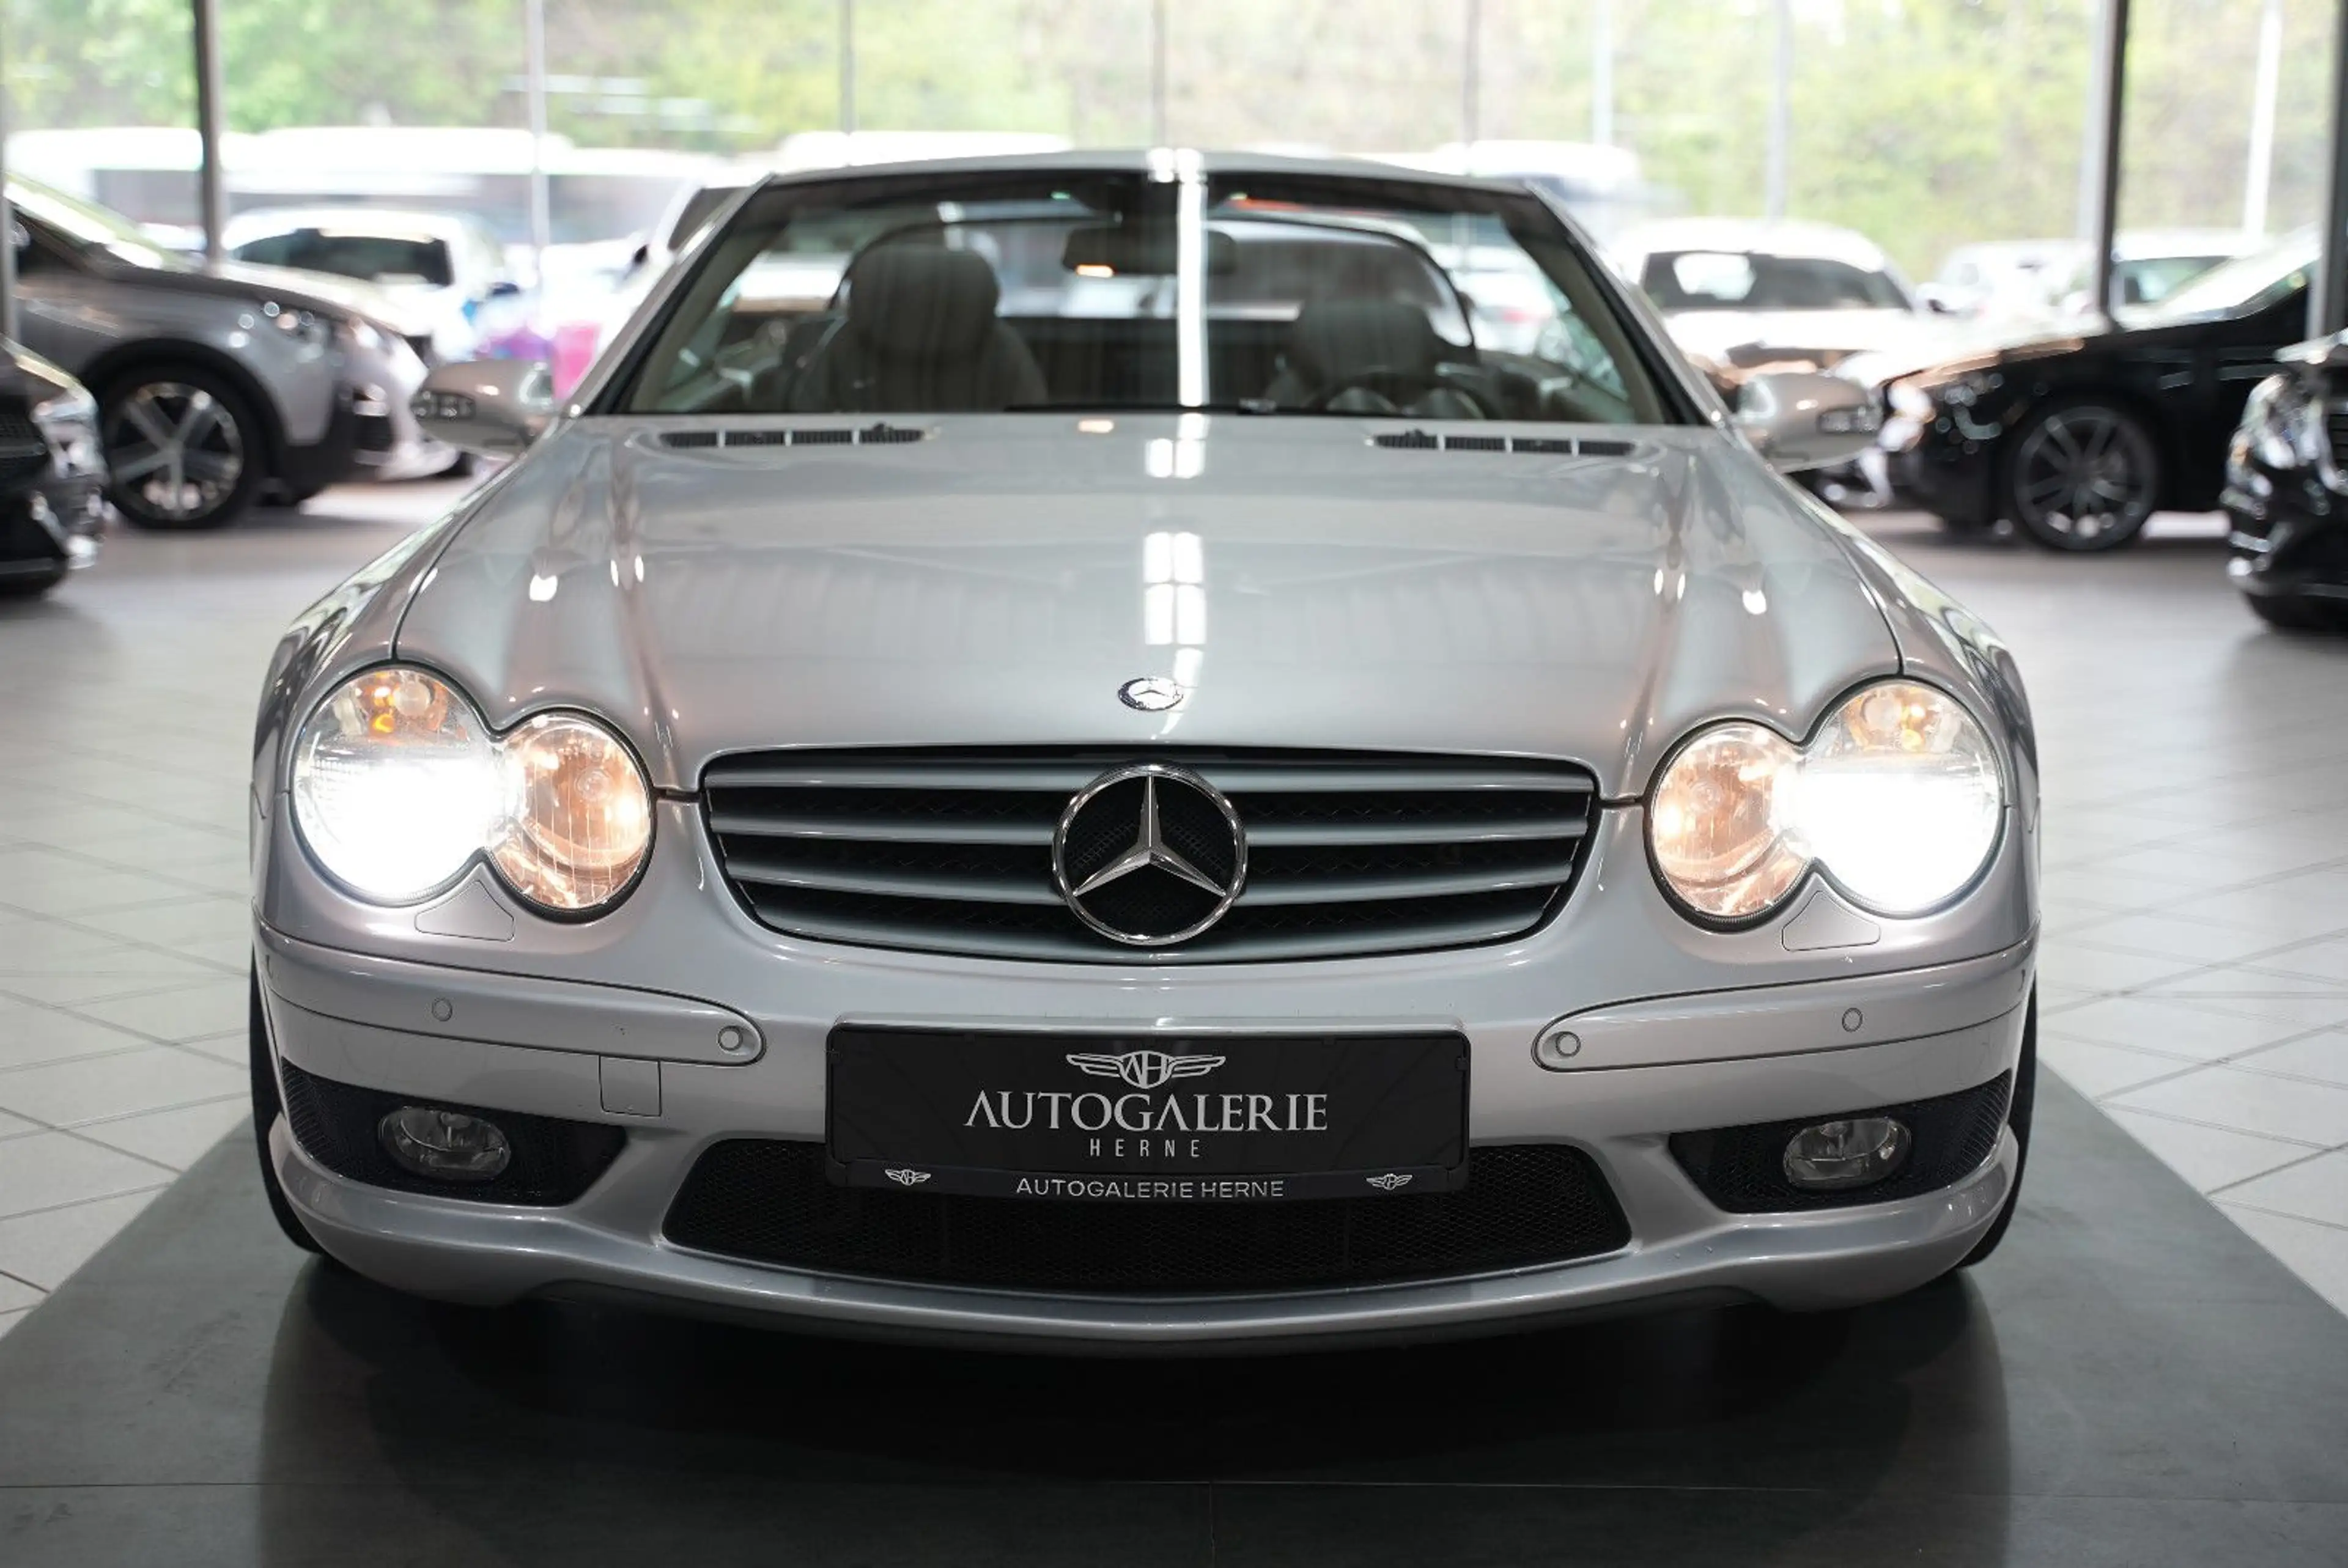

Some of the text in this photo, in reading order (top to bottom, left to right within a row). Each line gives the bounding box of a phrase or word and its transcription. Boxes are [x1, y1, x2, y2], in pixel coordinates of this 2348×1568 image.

[964, 1091, 1327, 1132] AUTOGALERIE
[1090, 1138, 1200, 1158] HERNE
[1016, 1177, 1283, 1198] AUTOGALERIE HERNE
